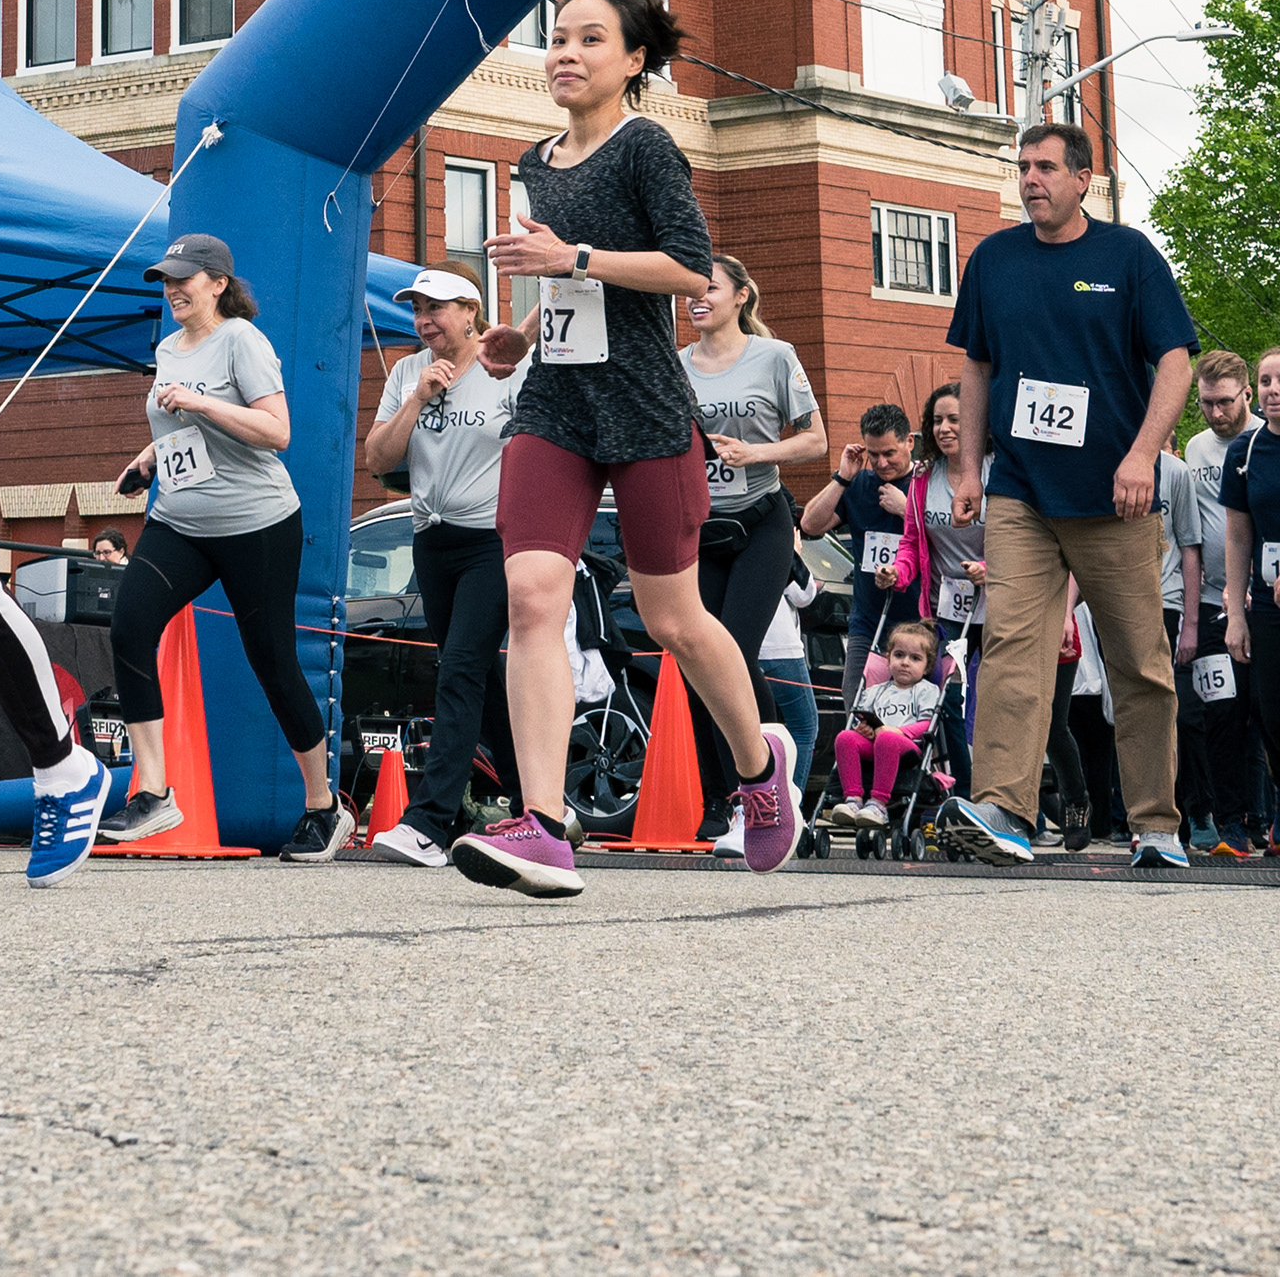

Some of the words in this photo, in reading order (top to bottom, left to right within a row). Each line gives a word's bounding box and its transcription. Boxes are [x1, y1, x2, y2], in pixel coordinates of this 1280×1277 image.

[542, 307, 575, 342] 37
[1027, 401, 1074, 430] 142
[163, 446, 197, 478] 121
[953, 592, 975, 614] 95
[1198, 669, 1226, 692] 115
